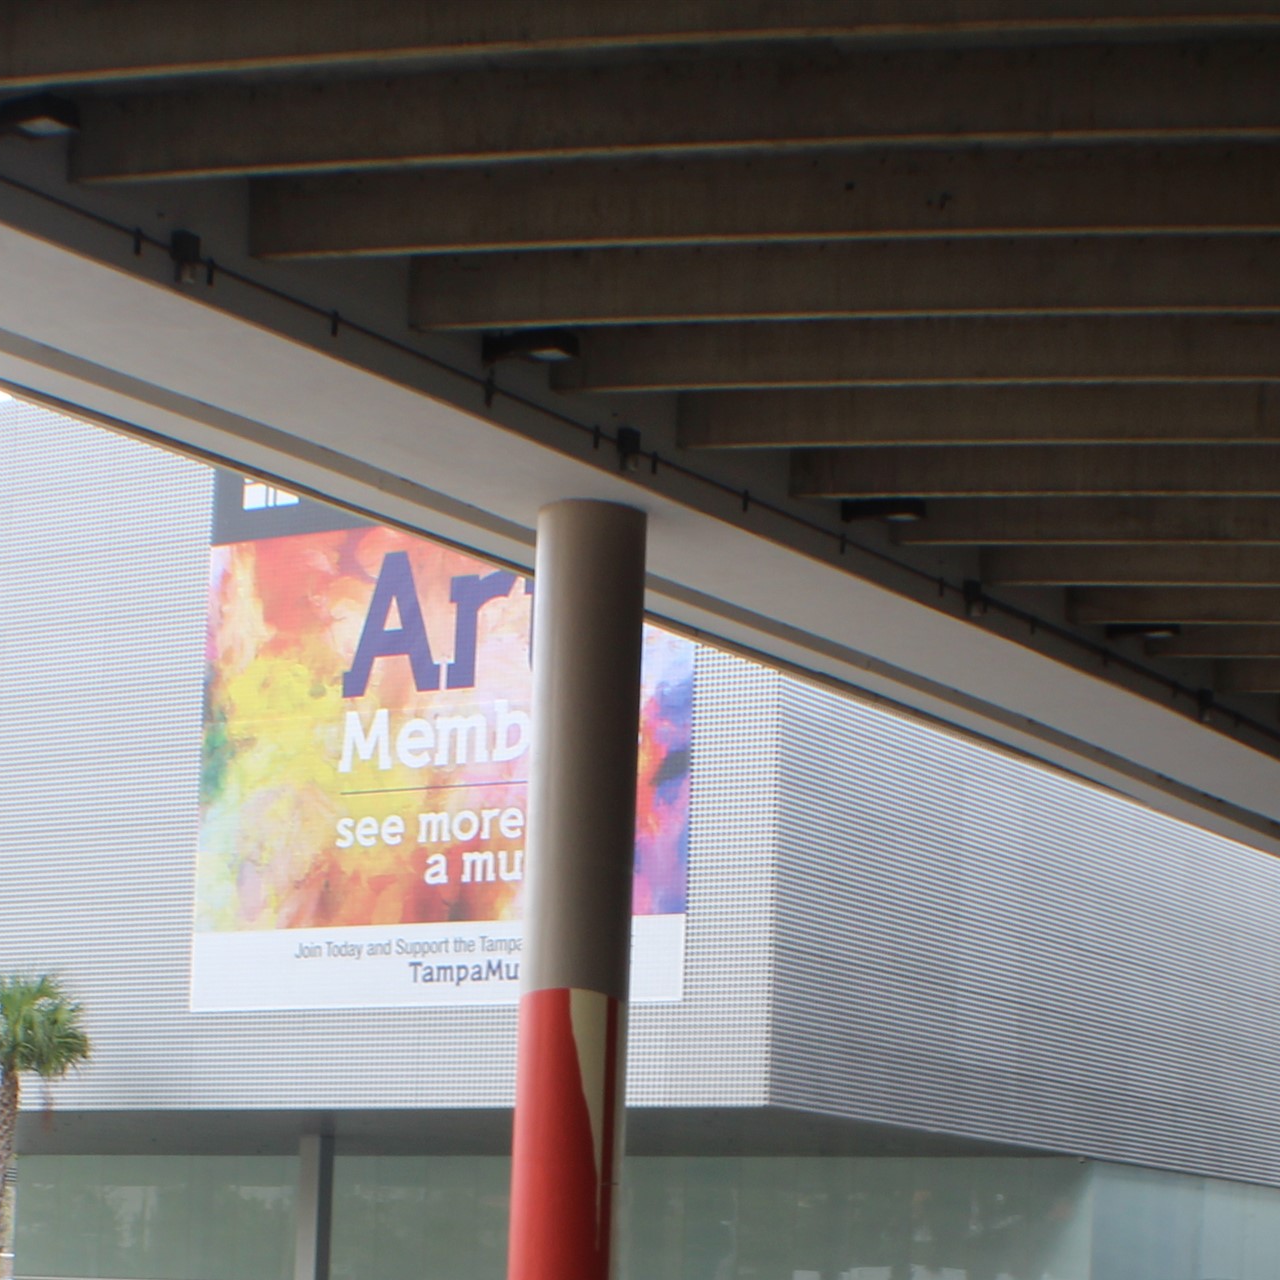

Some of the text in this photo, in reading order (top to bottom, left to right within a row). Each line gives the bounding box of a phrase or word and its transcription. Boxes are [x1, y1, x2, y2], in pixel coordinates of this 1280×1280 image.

[342, 550, 534, 698] Ar
[335, 806, 525, 849] see more
[424, 852, 448, 884] a
[294, 942, 323, 959] Join
[325, 941, 363, 961] Today
[366, 940, 392, 957] and
[395, 938, 450, 958] Support
[453, 936, 476, 954] the
